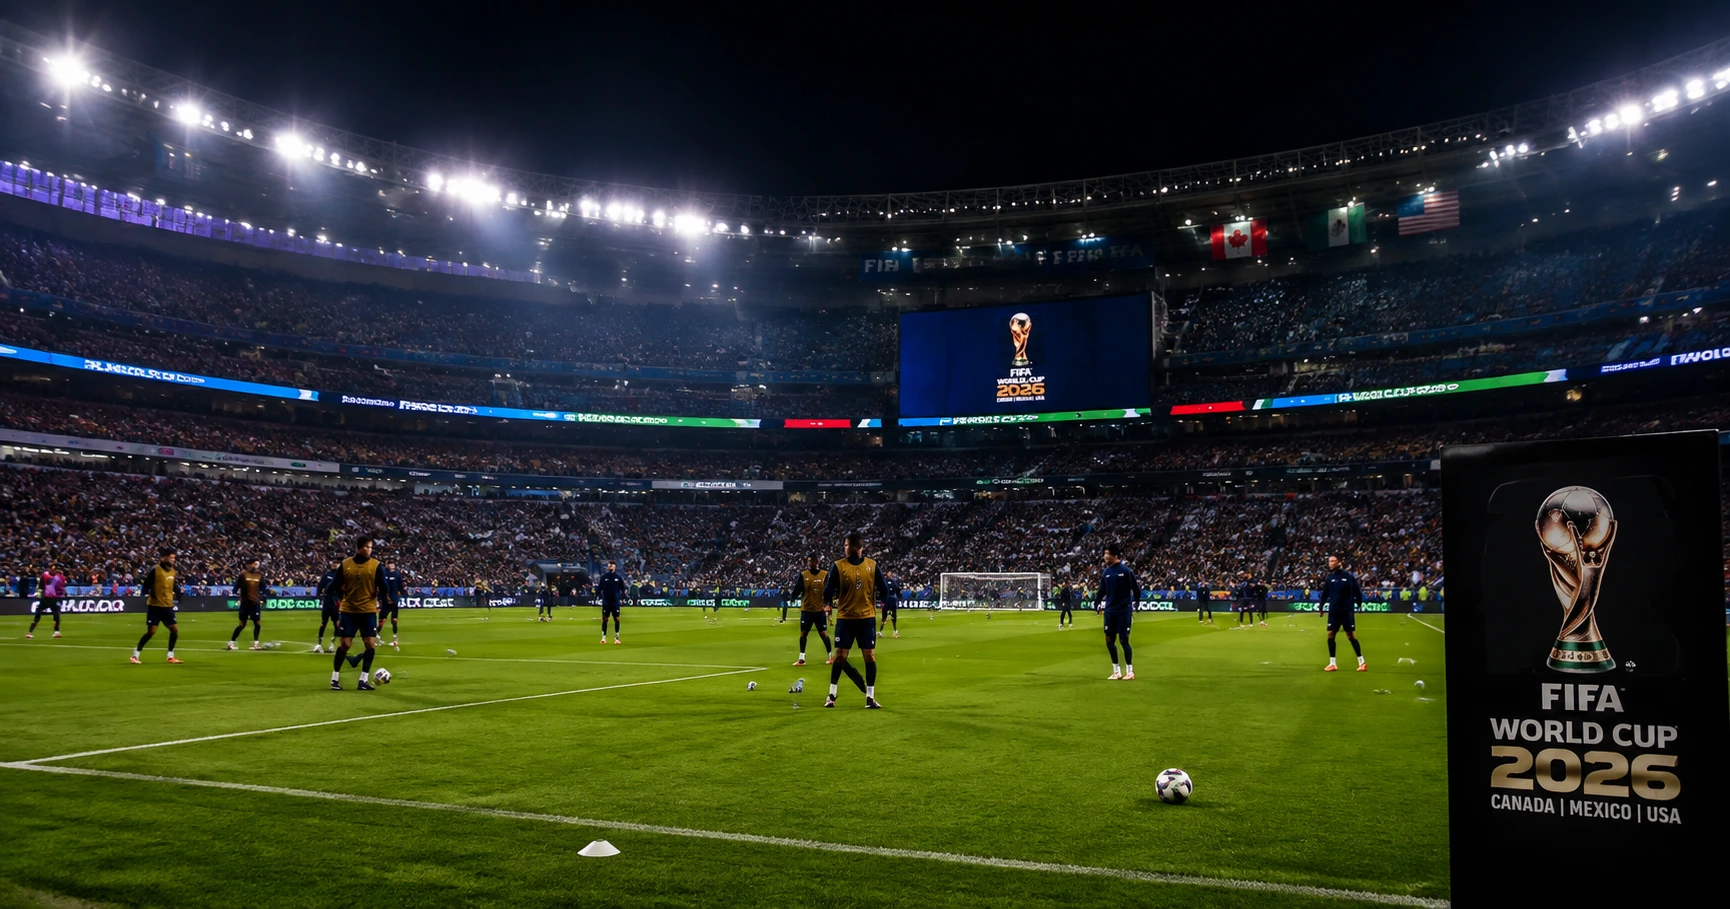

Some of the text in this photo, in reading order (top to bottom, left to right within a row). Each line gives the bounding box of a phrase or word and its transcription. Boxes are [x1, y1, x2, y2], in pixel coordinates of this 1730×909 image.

[1010, 368, 1032, 377] FIFA
[997, 383, 1045, 397] 2026
[1541, 683, 1625, 713] FIFA
[1490, 718, 1679, 749] WORLD CUP
[1490, 745, 1681, 801] 2026
[1491, 794, 1682, 825] CANADA MEXICO USA
